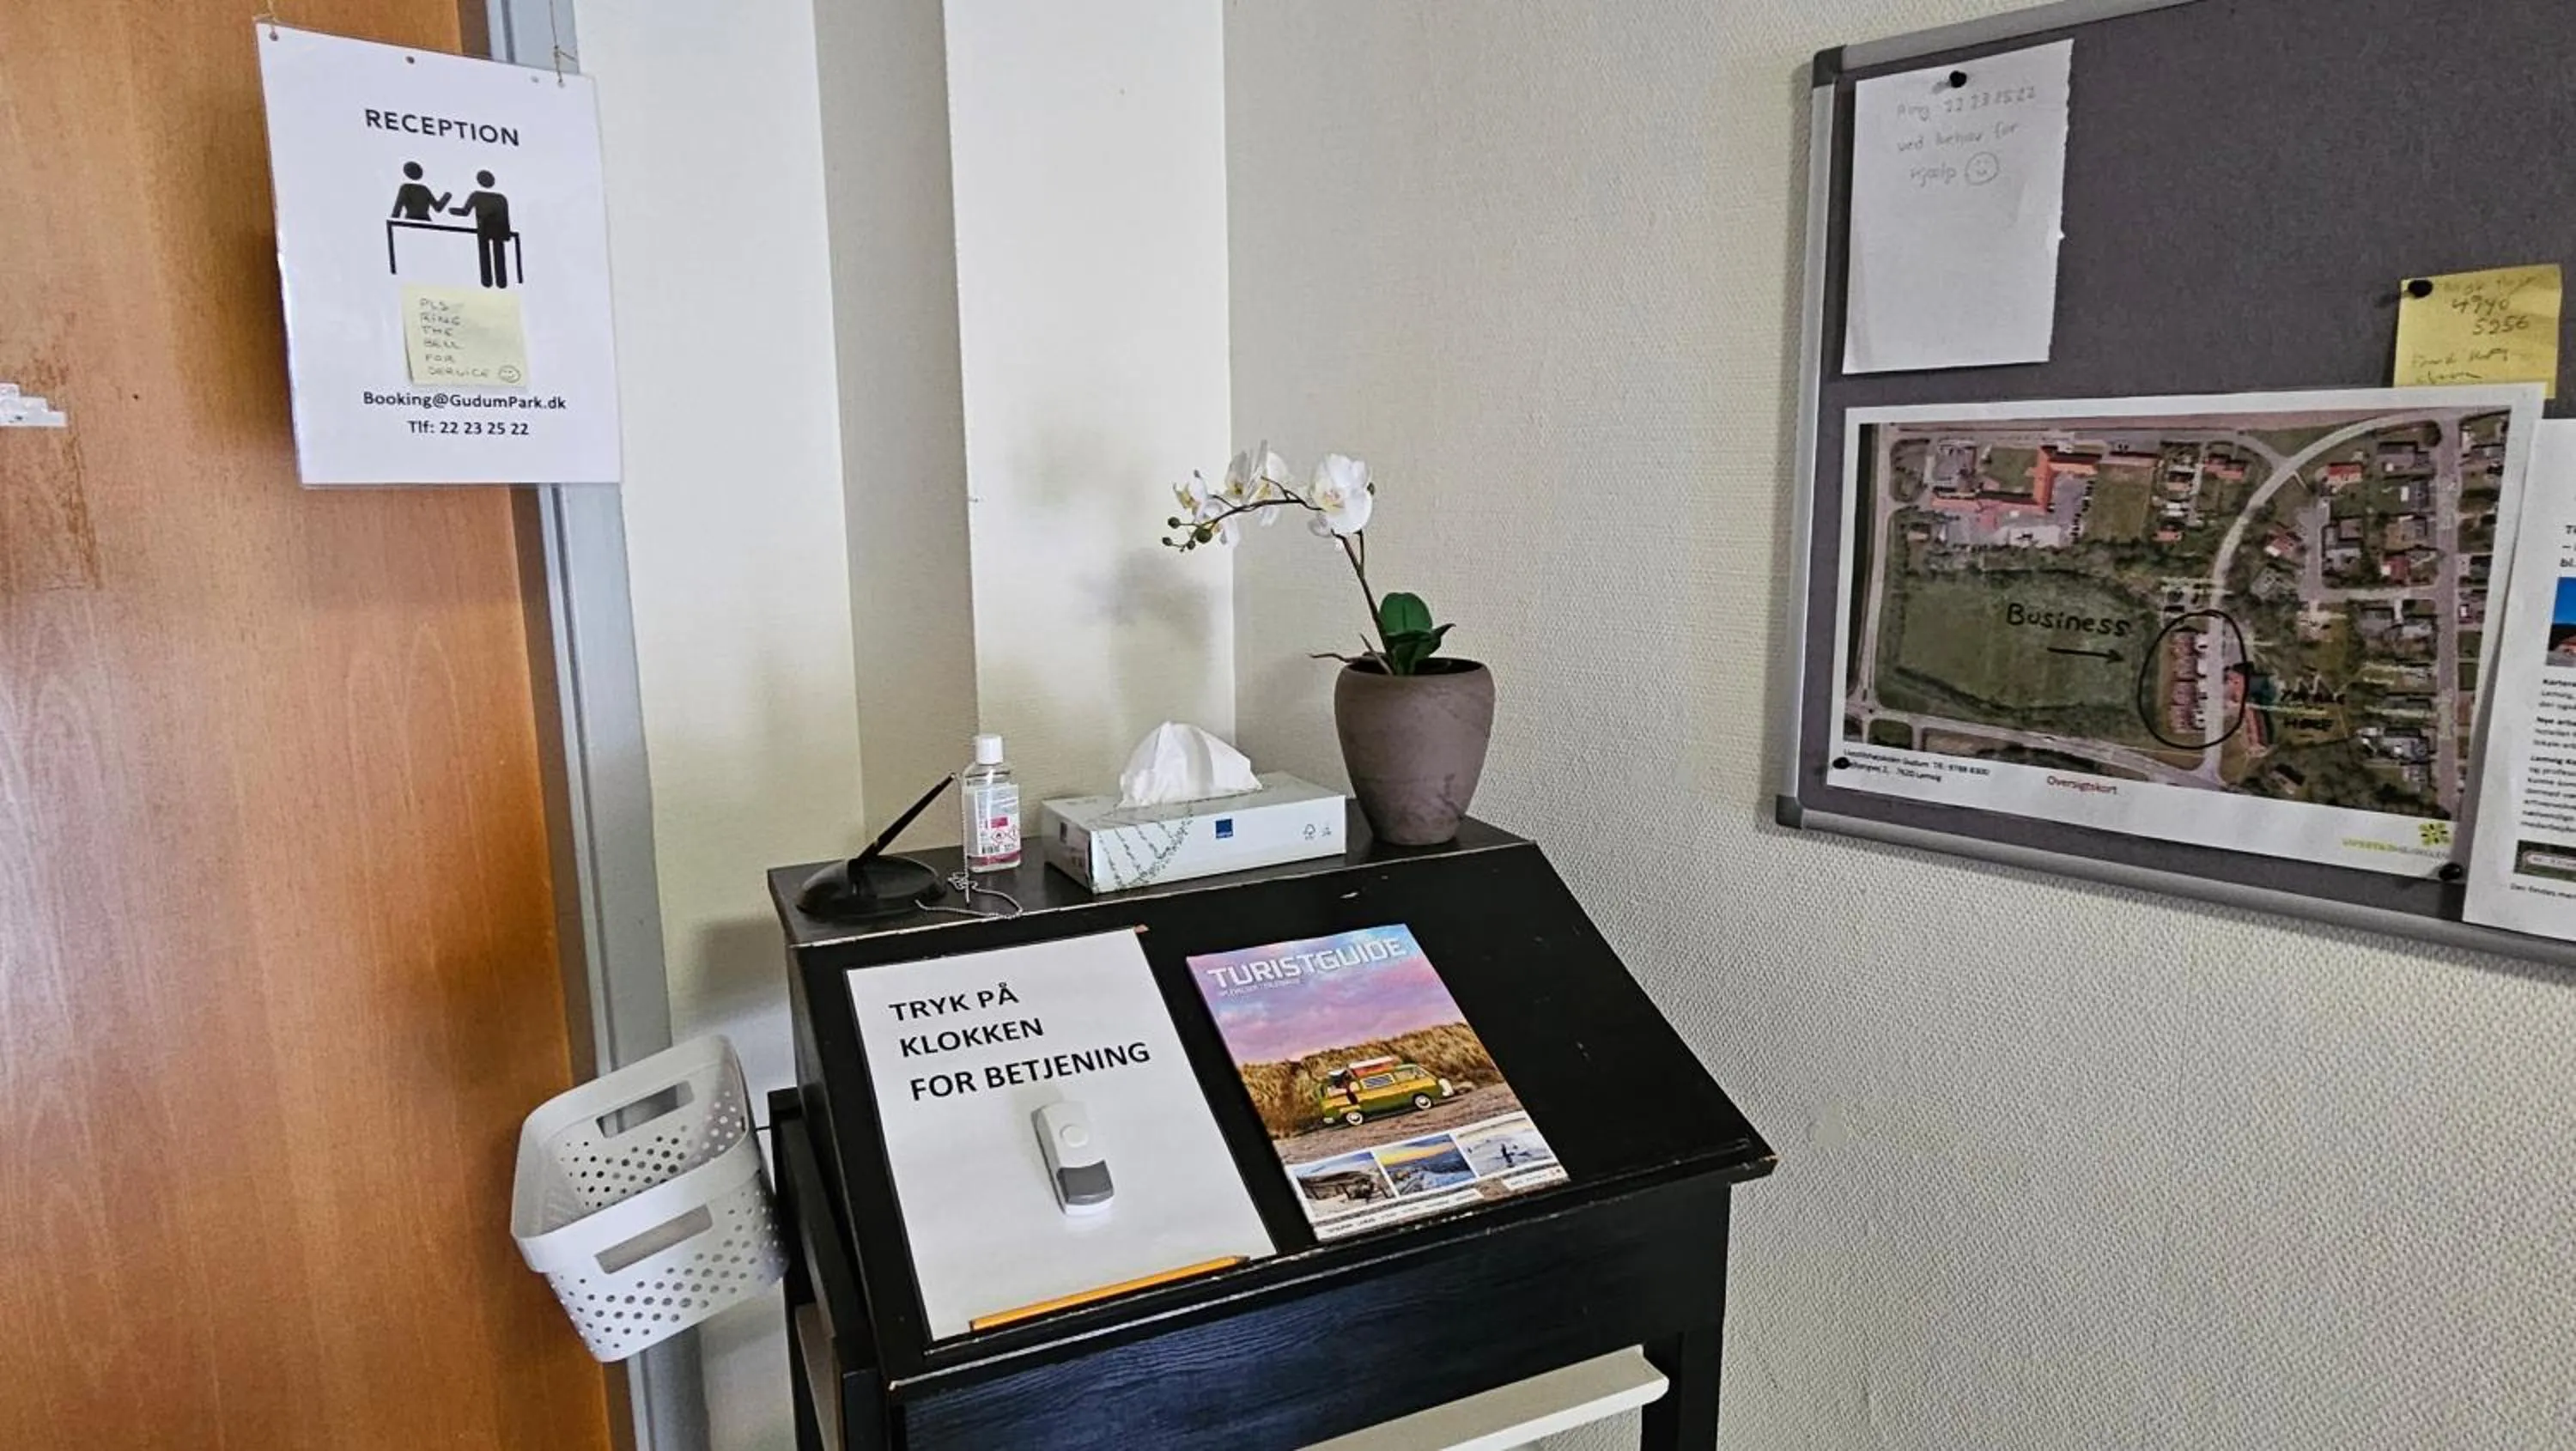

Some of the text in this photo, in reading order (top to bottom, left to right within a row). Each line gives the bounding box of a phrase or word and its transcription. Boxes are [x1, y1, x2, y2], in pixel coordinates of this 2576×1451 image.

[365, 108, 519, 147] RECEPTION
[362, 391, 567, 410] Booking@GudumPark.dk
[408, 420, 530, 435] Tlf: 22 23 25 22
[2006, 602, 2131, 637] Business
[1206, 937, 1407, 988] TURISTGUIDE
[888, 981, 1019, 1022] TRYK PÅ
[899, 1017, 1044, 1058] KLOKKEN
[910, 1041, 1151, 1101] FOR BETJENING
